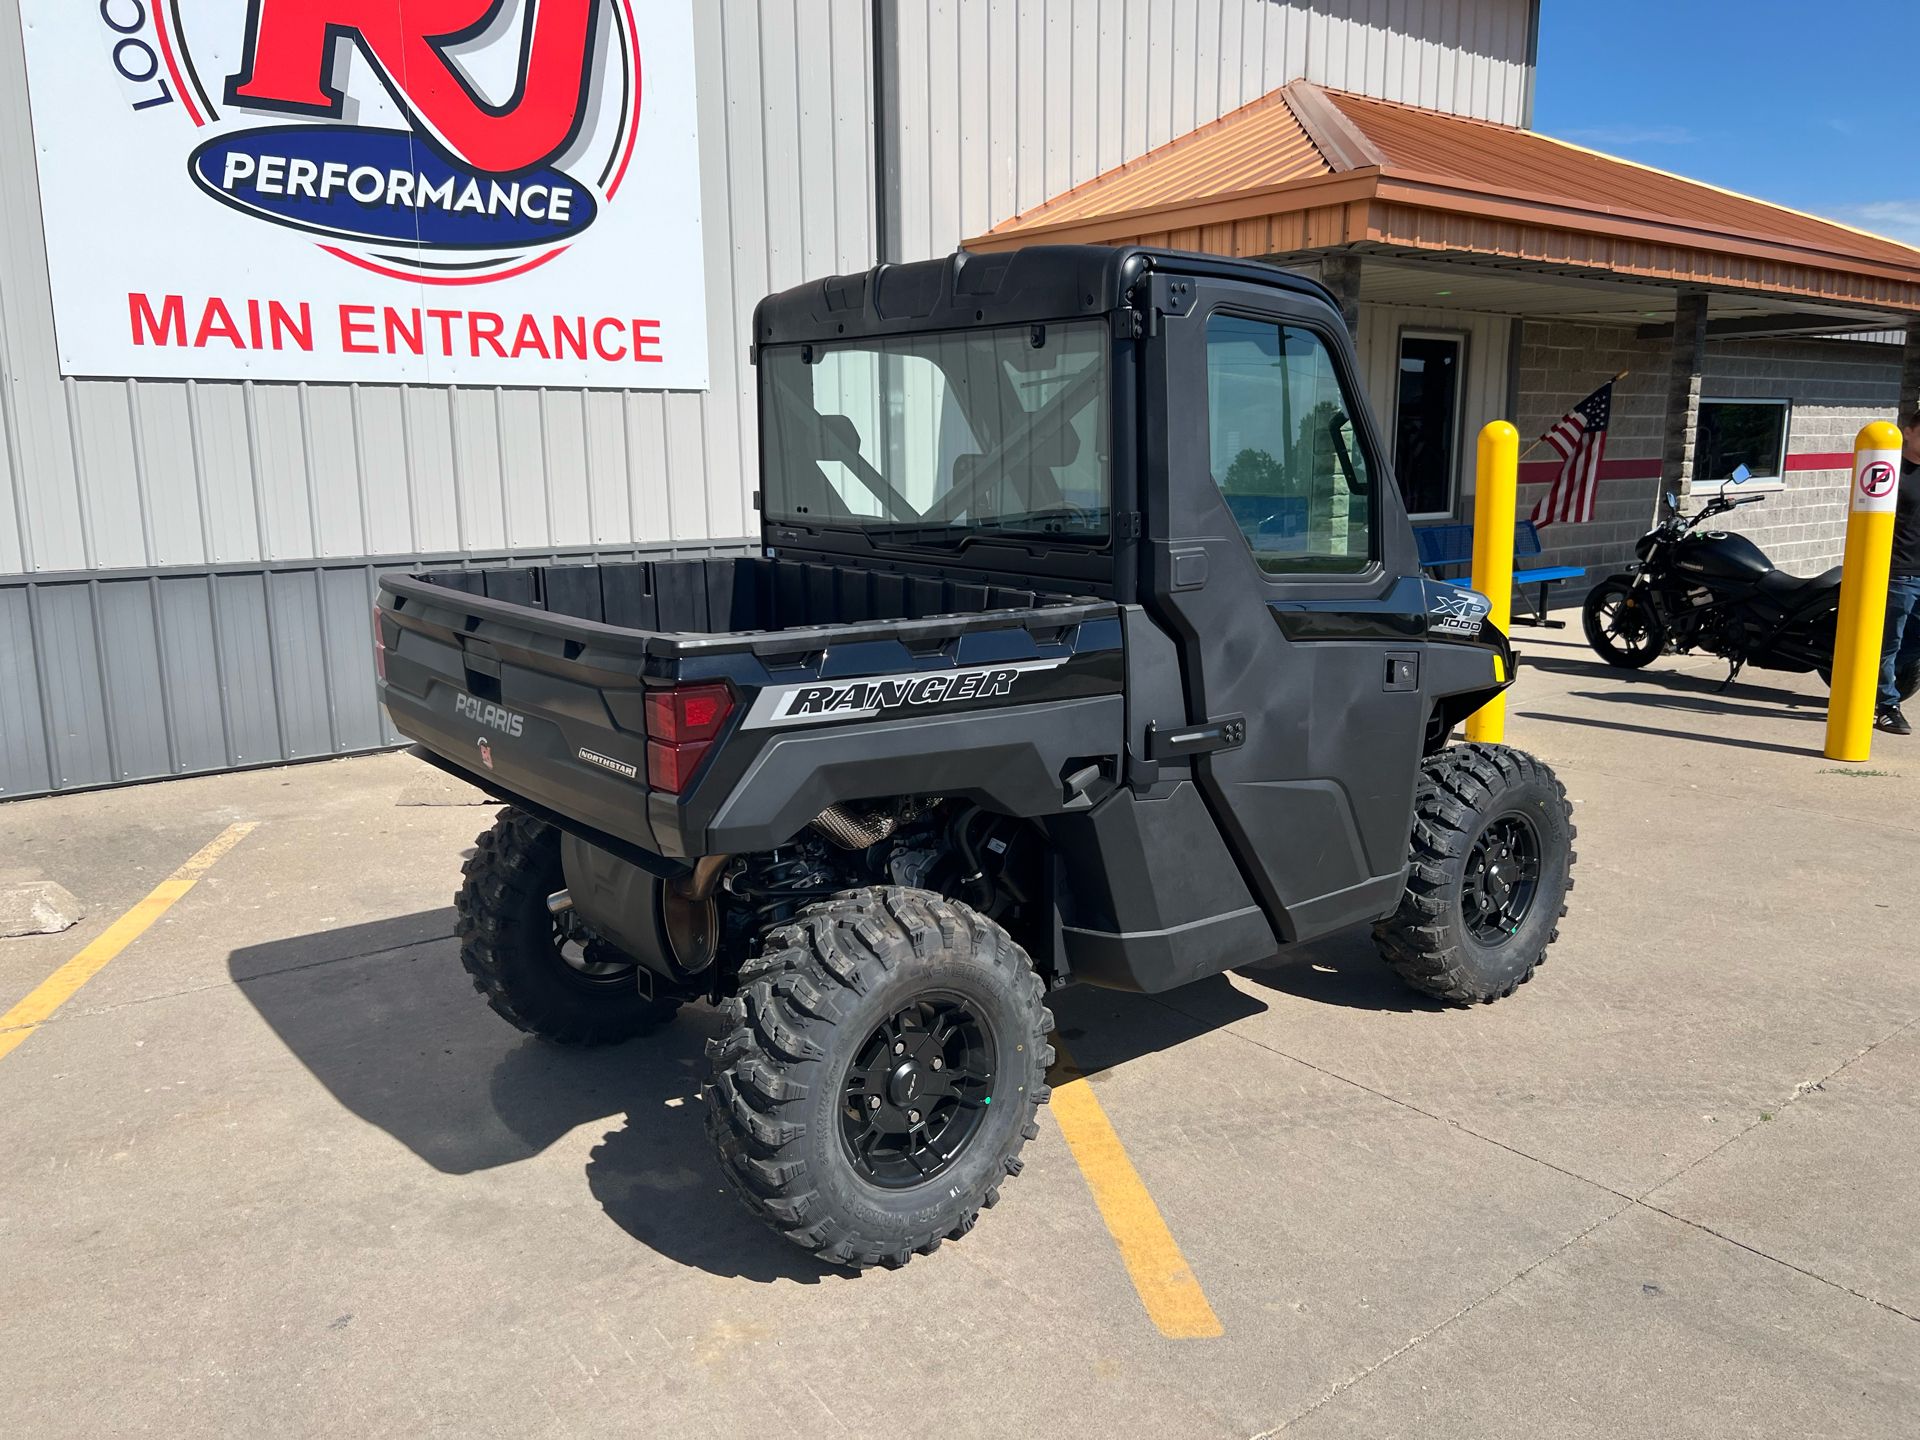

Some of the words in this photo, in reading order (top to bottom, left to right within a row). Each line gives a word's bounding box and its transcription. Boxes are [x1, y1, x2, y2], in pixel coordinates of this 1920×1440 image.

[222, 151, 574, 222] PERFORMANCE
[128, 293, 314, 352] MAIN
[340, 304, 664, 363] ENTRANCE
[1429, 595, 1488, 617] XP
[1443, 616, 1482, 632] 1000
[455, 693, 524, 737] POLARIS
[785, 669, 1020, 717] RANGER
[579, 749, 637, 778] NORTHSTAR
